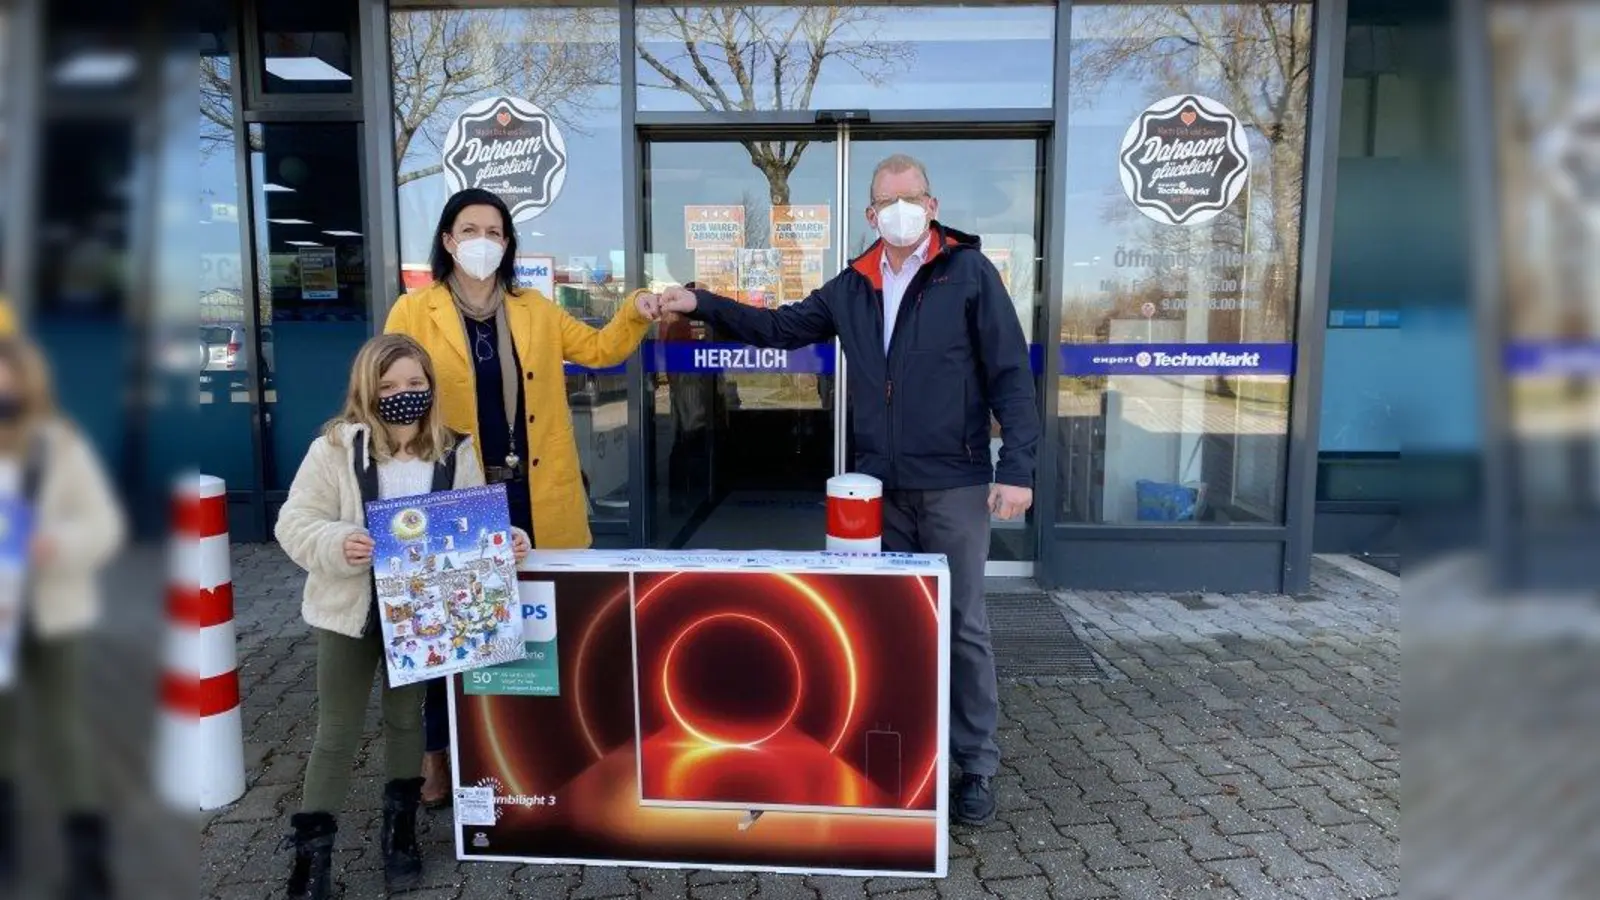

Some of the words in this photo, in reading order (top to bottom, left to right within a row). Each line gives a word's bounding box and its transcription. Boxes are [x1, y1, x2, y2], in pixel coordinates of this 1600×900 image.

[461, 136, 541, 166] Dahoam
[1139, 136, 1226, 164] Dahoam
[473, 154, 542, 188] glücklich!
[1148, 155, 1224, 188] glücklich!
[694, 349, 787, 368] HERZLICH
[1092, 356, 1133, 365] expert
[1153, 352, 1260, 367] TechnoMarkt
[472, 671, 492, 684] 50
[548, 795, 557, 805] 3
